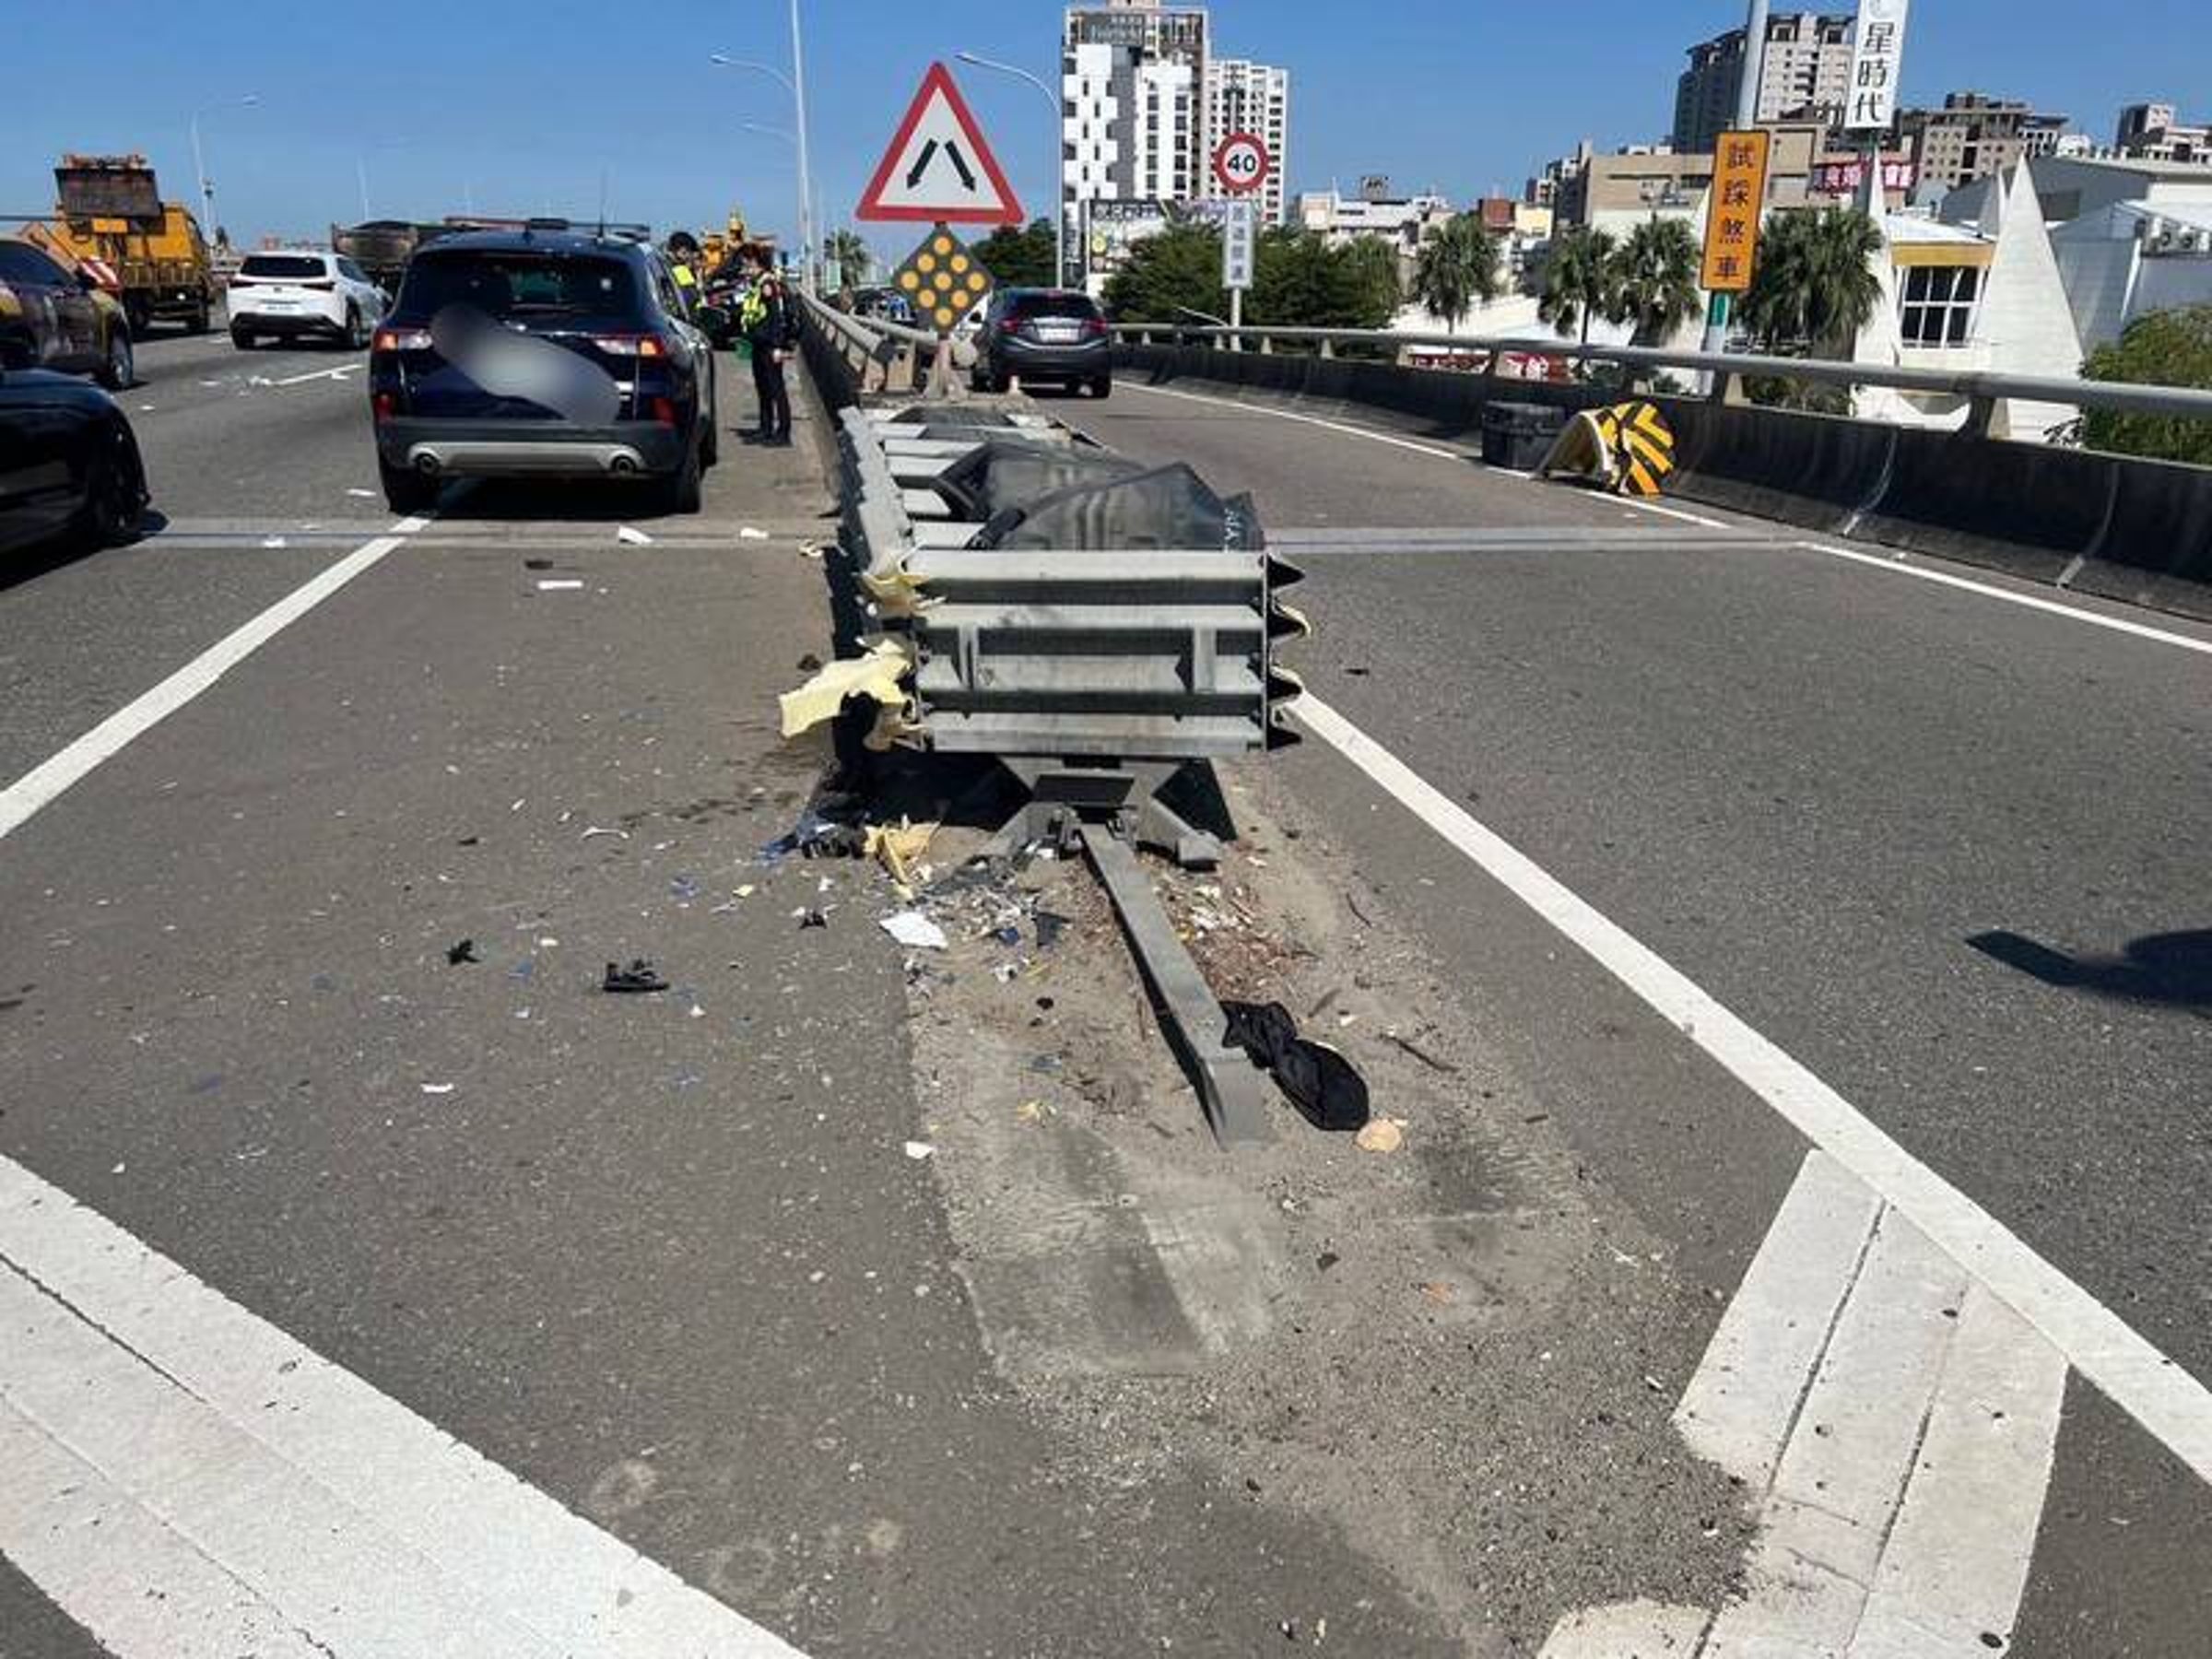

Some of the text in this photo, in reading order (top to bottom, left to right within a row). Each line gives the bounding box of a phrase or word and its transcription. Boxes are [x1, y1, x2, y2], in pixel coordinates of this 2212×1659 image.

[1854, 21, 1895, 123] 星時代
[1227, 154, 1256, 172] 40
